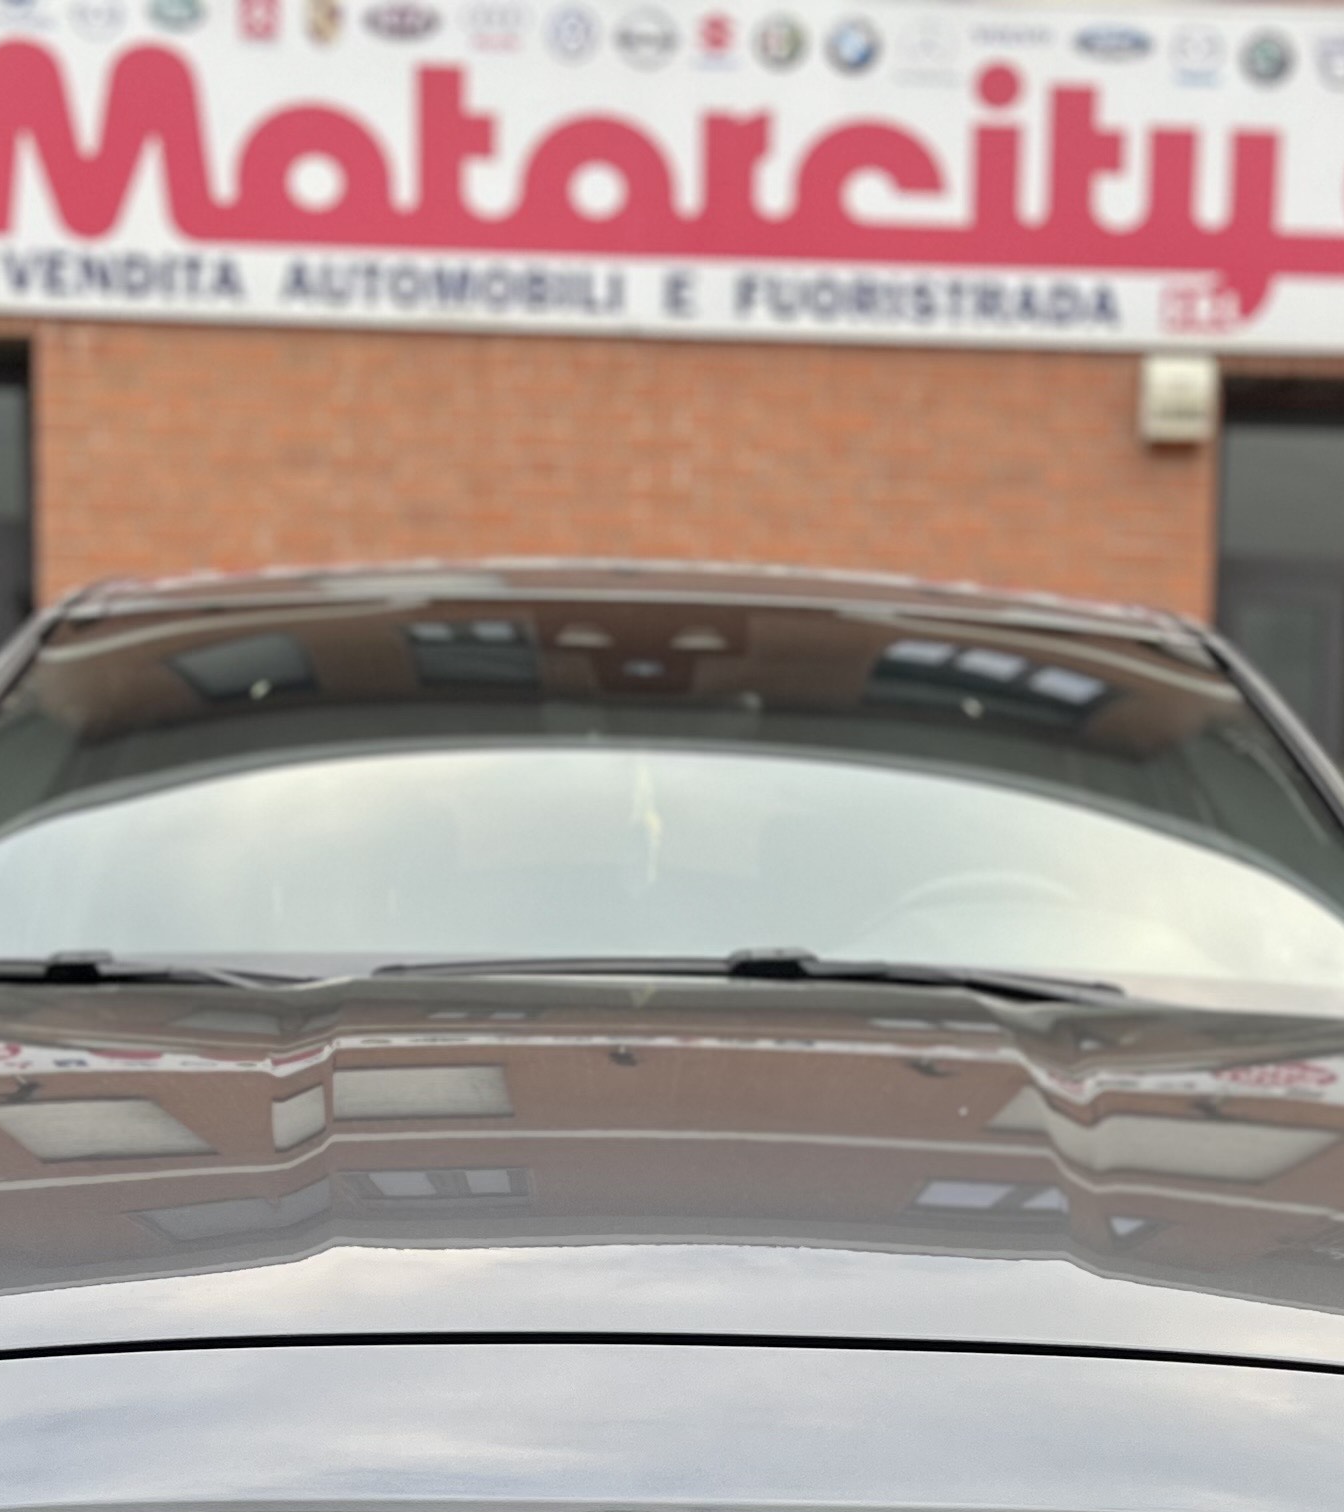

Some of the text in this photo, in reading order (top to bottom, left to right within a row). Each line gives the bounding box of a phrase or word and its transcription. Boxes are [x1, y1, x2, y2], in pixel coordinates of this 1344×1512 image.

[0, 248, 244, 300] VENDITA
[281, 256, 628, 316] AUTOMOBILI
[662, 270, 698, 320] E
[734, 272, 1123, 328] FUORISTRADA
